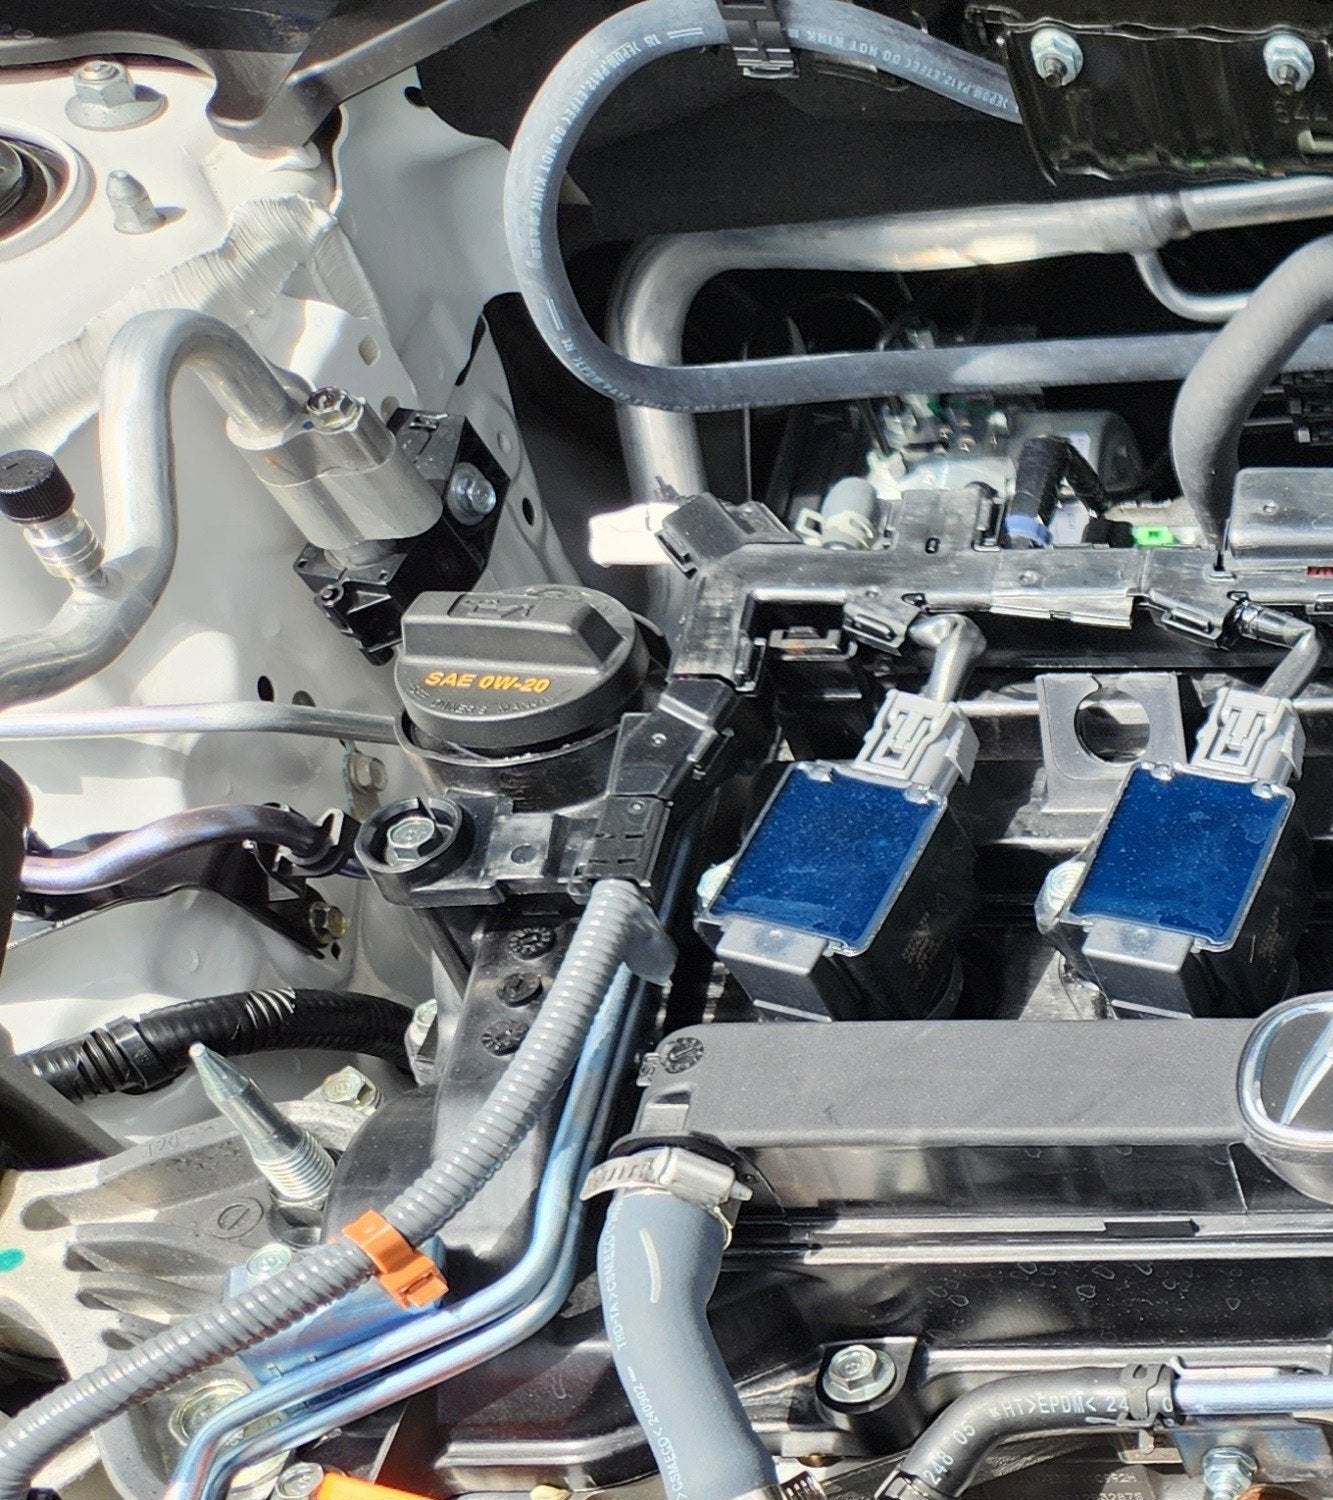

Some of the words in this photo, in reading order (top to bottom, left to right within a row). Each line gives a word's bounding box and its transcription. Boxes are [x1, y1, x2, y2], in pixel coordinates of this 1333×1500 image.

[424, 671, 477, 689] SAE
[479, 675, 551, 695] 0W-20
[633, 1382, 660, 1427] 240902
[1106, 1396, 1130, 1413] 24
[922, 1449, 955, 1486] 248
[952, 1420, 976, 1446] 05
